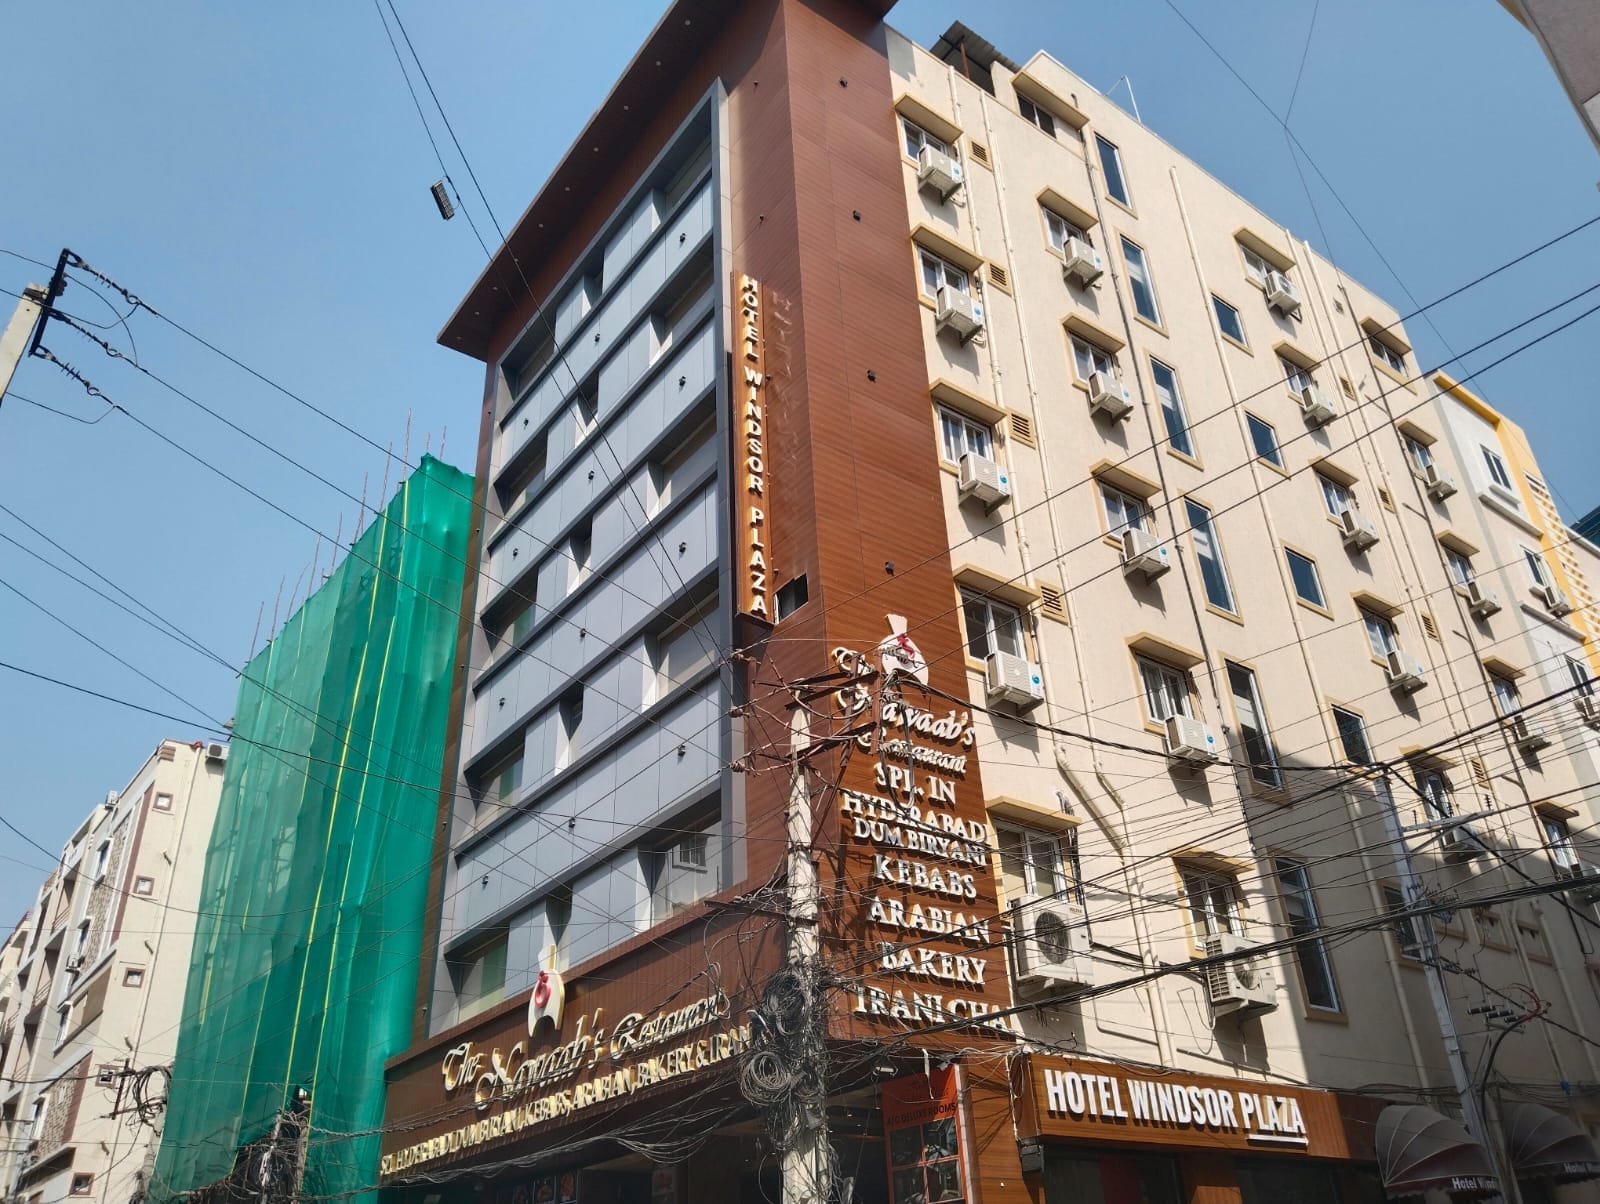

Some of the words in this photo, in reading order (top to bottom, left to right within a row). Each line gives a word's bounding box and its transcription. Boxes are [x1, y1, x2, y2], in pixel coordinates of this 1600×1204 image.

[743, 273, 759, 363] HOTEL
[744, 366, 764, 495] WINDSOR
[749, 507, 768, 616] PLAZA
[926, 775, 957, 805] IN
[853, 817, 904, 848] DUM
[906, 829, 988, 867] BIRYANI
[873, 853, 977, 899] KEBABS
[867, 896, 990, 943] ARABIAN
[880, 942, 988, 985] BAKERY
[853, 985, 946, 1023] IRANI
[442, 1041, 487, 1091] The
[637, 1043, 695, 1088] BAKERY
[695, 1039, 710, 1068] &
[1044, 1069, 1128, 1119] HOTEL
[1127, 1079, 1238, 1129] WINDSOR
[1238, 1091, 1307, 1134] PLAZA
[1451, 1177, 1478, 1189] Hotel
